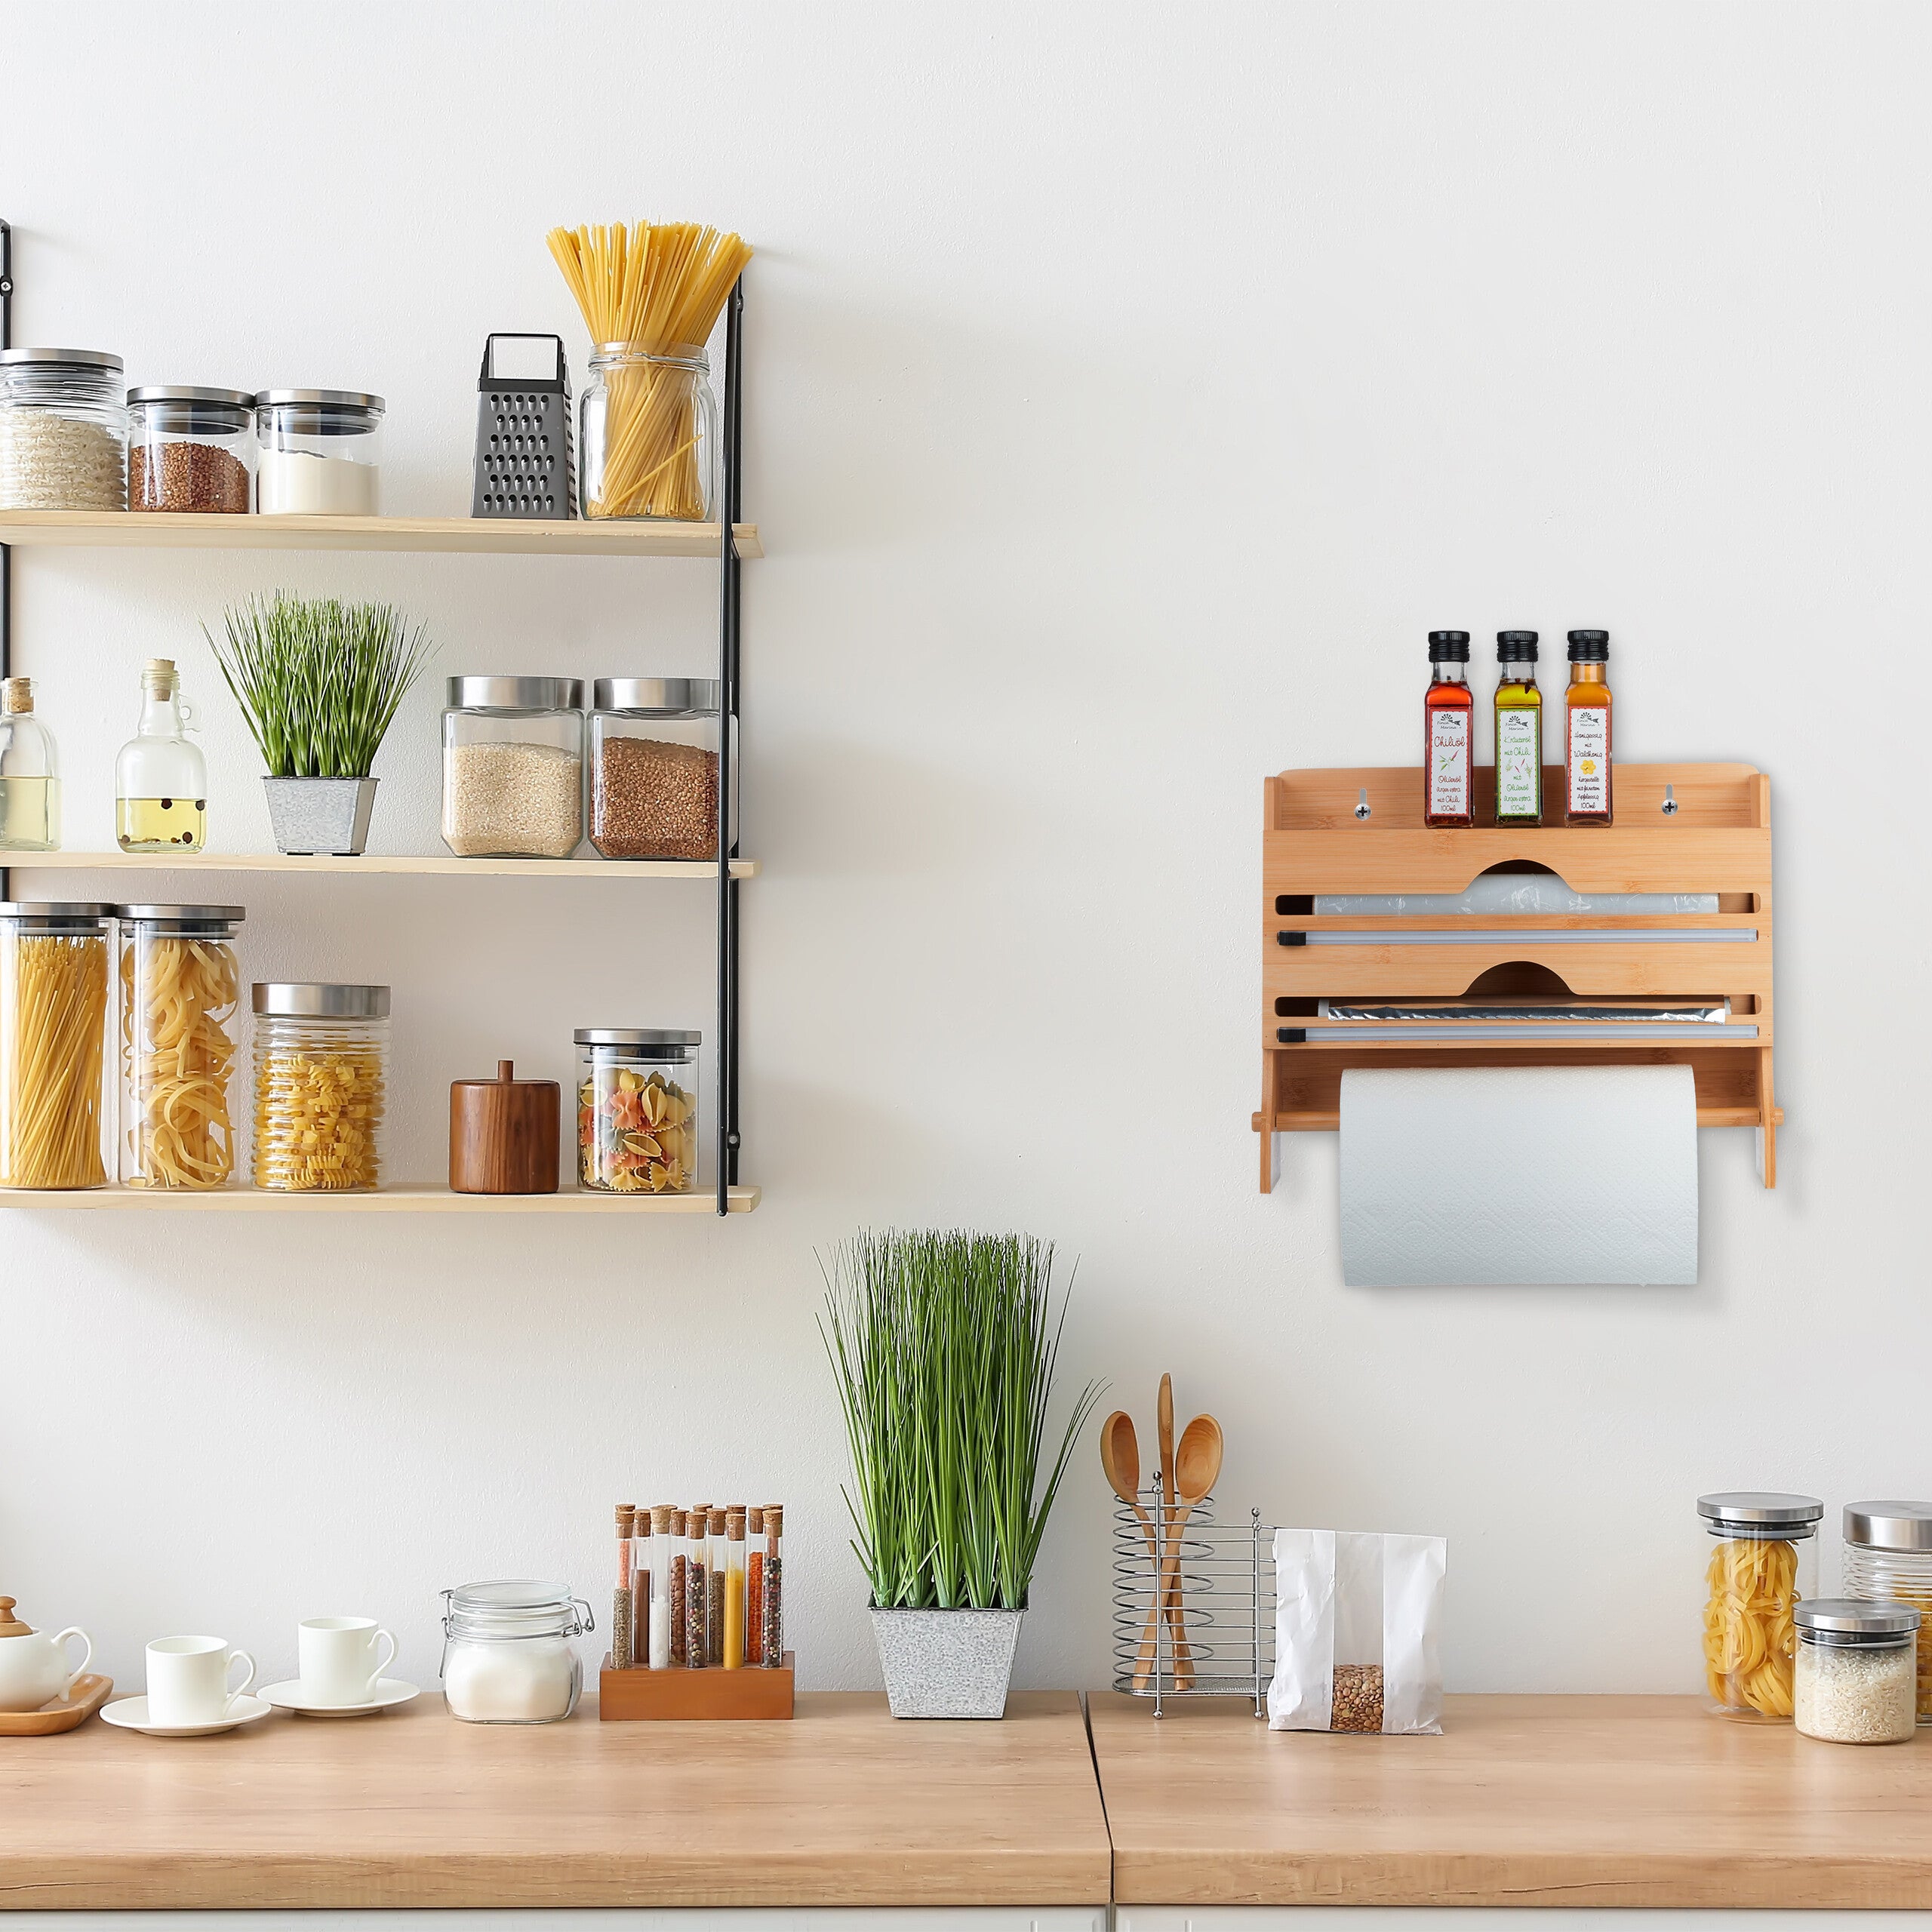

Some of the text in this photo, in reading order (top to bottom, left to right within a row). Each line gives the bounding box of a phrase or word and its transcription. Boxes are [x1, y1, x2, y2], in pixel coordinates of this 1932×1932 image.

[1434, 736, 1466, 747] Chiliöl
[1514, 746, 1531, 756] Chili
[1445, 795, 1460, 803] Chili
